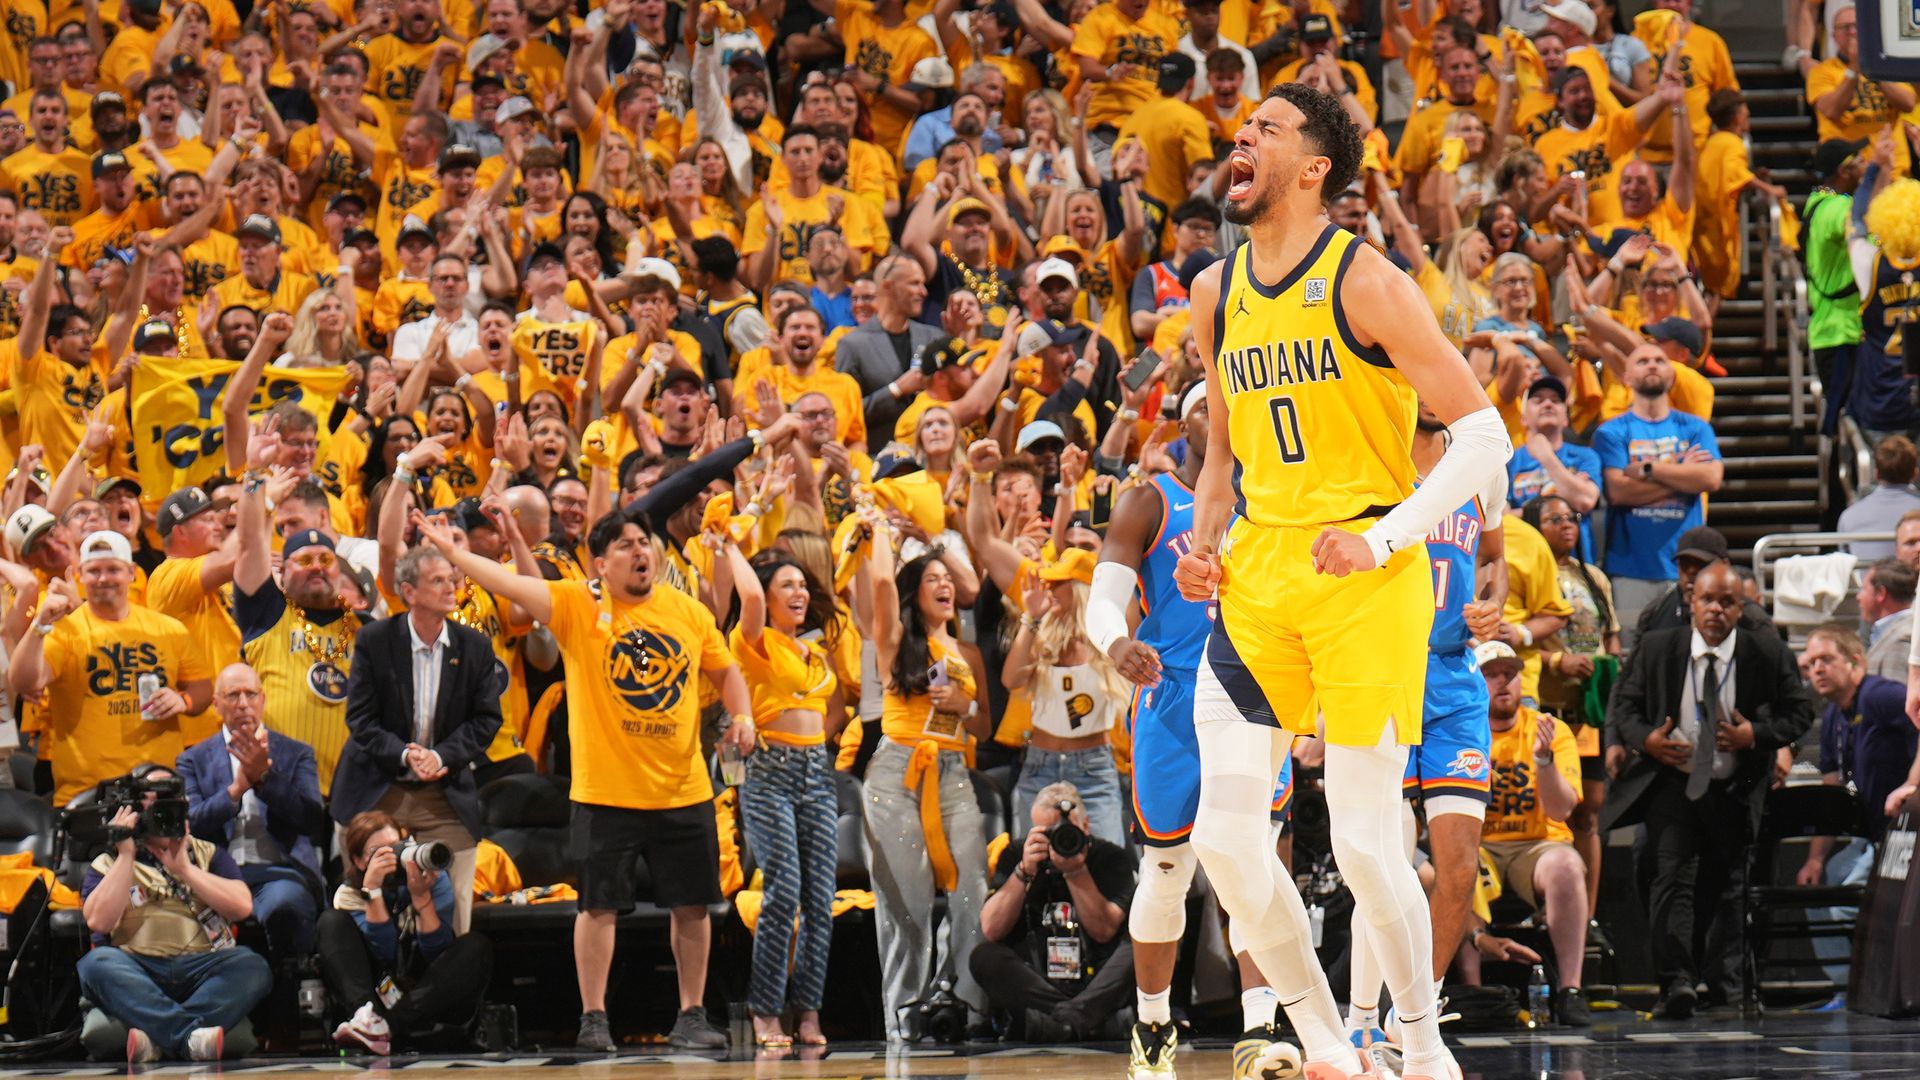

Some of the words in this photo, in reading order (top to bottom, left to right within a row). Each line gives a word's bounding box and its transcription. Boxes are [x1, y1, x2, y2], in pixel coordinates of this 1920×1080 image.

[530, 329, 579, 352] YES
[537, 353, 586, 377] ERS
[1223, 338, 1341, 395] INDIANA
[1269, 397, 1305, 464] 0
[1427, 511, 1479, 554] NDER
[99, 642, 158, 672] YES
[611, 652, 689, 690] INDY
[1061, 676, 1071, 691] 0
[107, 701, 131, 716] 2025
[620, 720, 641, 734] 2025
[1491, 761, 1528, 788] ES
[1488, 789, 1534, 816] ERS
